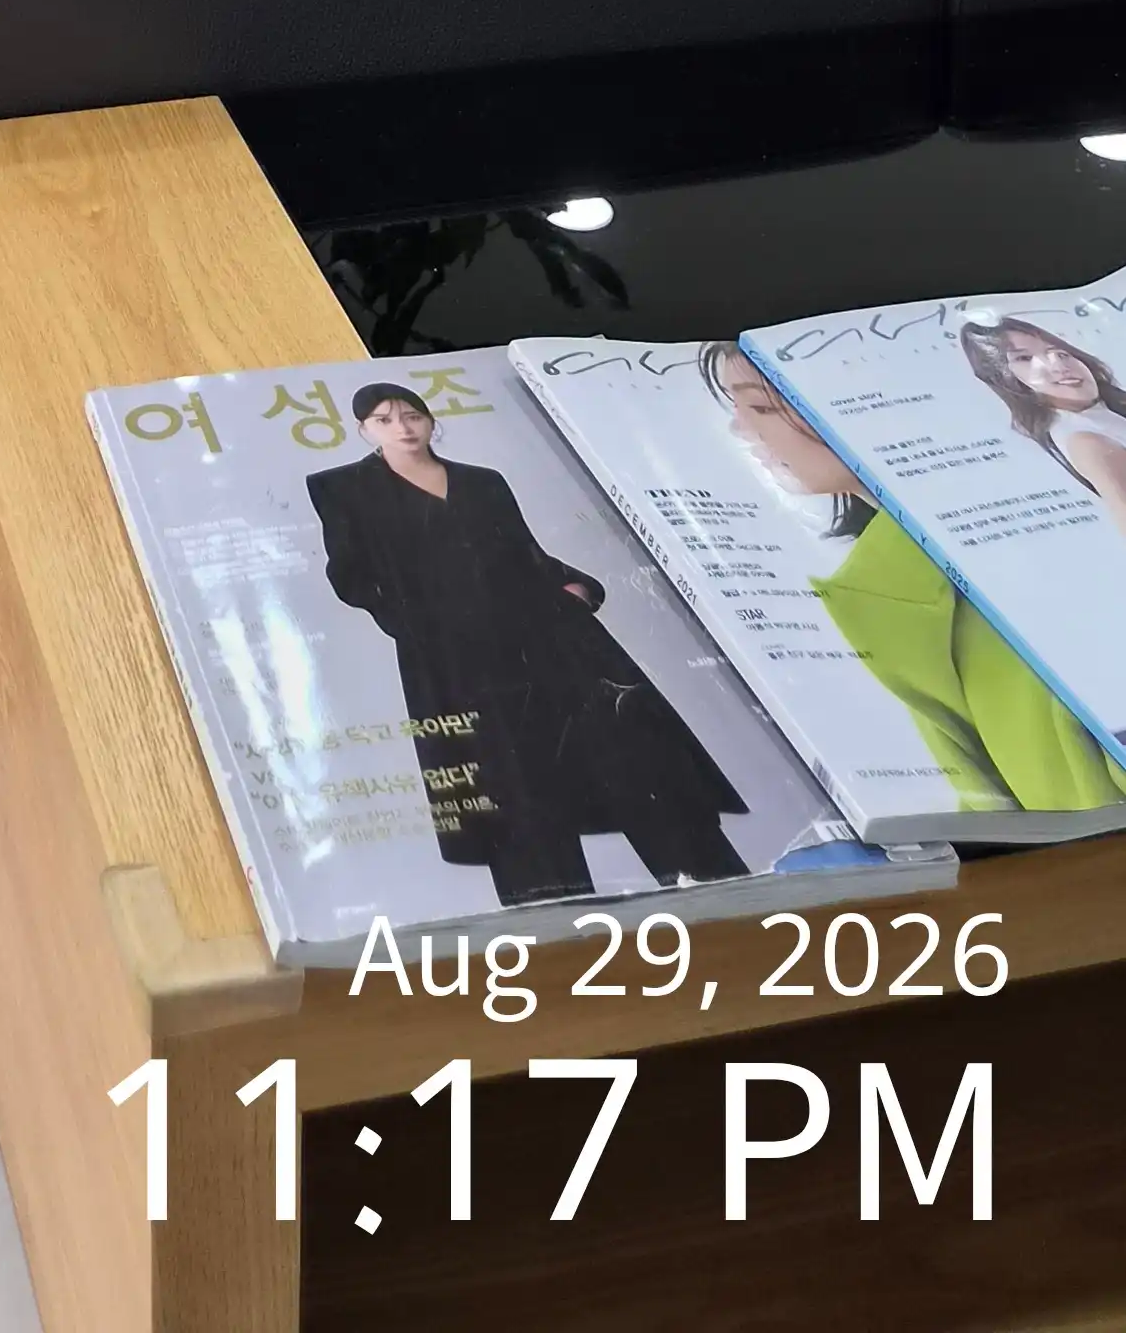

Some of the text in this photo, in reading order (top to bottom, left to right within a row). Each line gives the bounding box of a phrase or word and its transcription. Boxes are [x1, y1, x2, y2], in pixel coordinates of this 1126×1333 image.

[609, 483, 670, 570] DECEMBER
[676, 573, 699, 606] 2021
[944, 560, 971, 595] 2025
[735, 607, 768, 622] STAR
